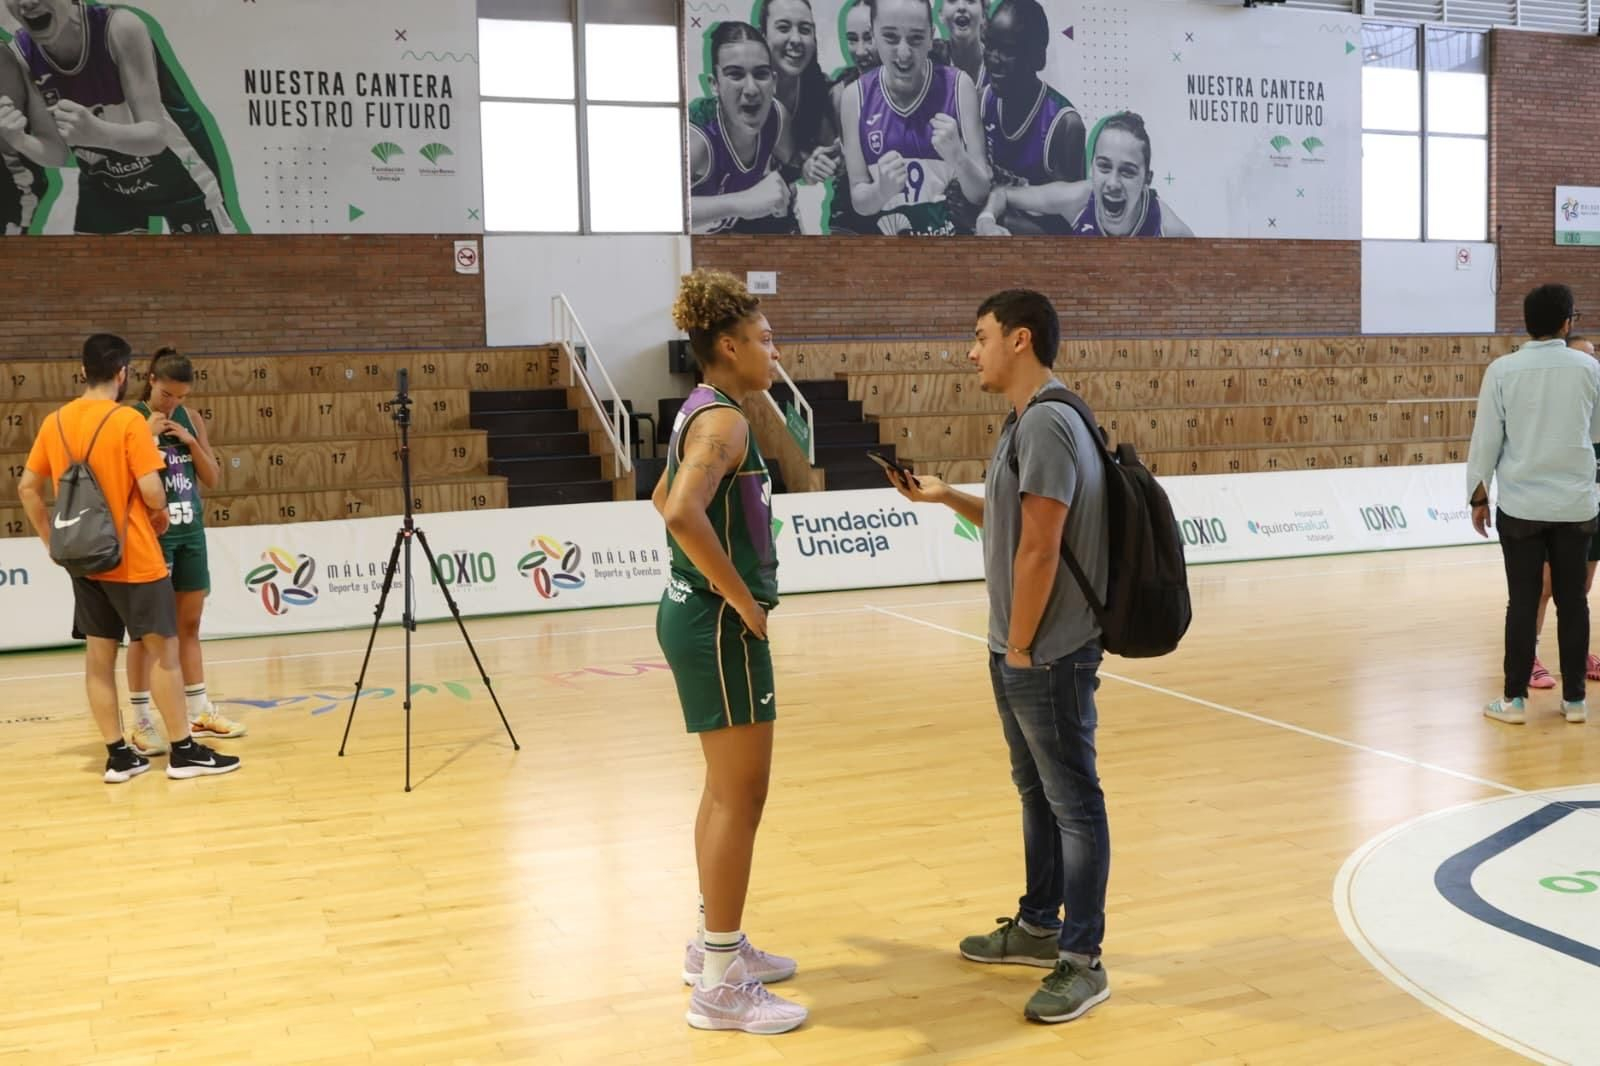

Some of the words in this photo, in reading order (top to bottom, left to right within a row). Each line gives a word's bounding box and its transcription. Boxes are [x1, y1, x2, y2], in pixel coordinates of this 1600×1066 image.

[244, 69, 344, 96] NUESTRA
[356, 72, 453, 98] CANTERA
[1187, 74, 1253, 98] NUESTRA
[1261, 78, 1324, 101] CANTERA
[249, 100, 353, 128] NUESTRO
[366, 103, 451, 130] FUTURO
[1190, 99, 1258, 124] NUESTRO
[1267, 103, 1323, 127] FUTURO
[12, 375, 25, 388] 12
[195, 370, 207, 380] 15
[254, 369, 266, 379] 16
[309, 367, 322, 376] 17
[365, 365, 378, 375] 18
[423, 364, 435, 373] 19
[476, 363, 488, 373] 20
[527, 363, 538, 371] 21
[8, 415, 23, 426] 12
[259, 407, 272, 417] 16
[319, 405, 333, 415] 17
[377, 402, 391, 413] 18
[434, 401, 446, 411] 19
[9, 466, 24, 477] 12
[269, 455, 283, 465] 16
[332, 453, 346, 464] 17
[453, 447, 466, 457] 19
[7, 521, 22, 533] 12
[214, 510, 229, 520] 15
[280, 506, 295, 517] 16
[346, 502, 362, 513] 17
[472, 496, 485, 506] 19
[168, 501, 193, 524] 55
[792, 507, 918, 534] Fundación
[592, 547, 659, 565] MÁLAGA
[798, 531, 890, 557] Unicaja
[328, 581, 360, 594] Deporte
[363, 583, 368, 594] y
